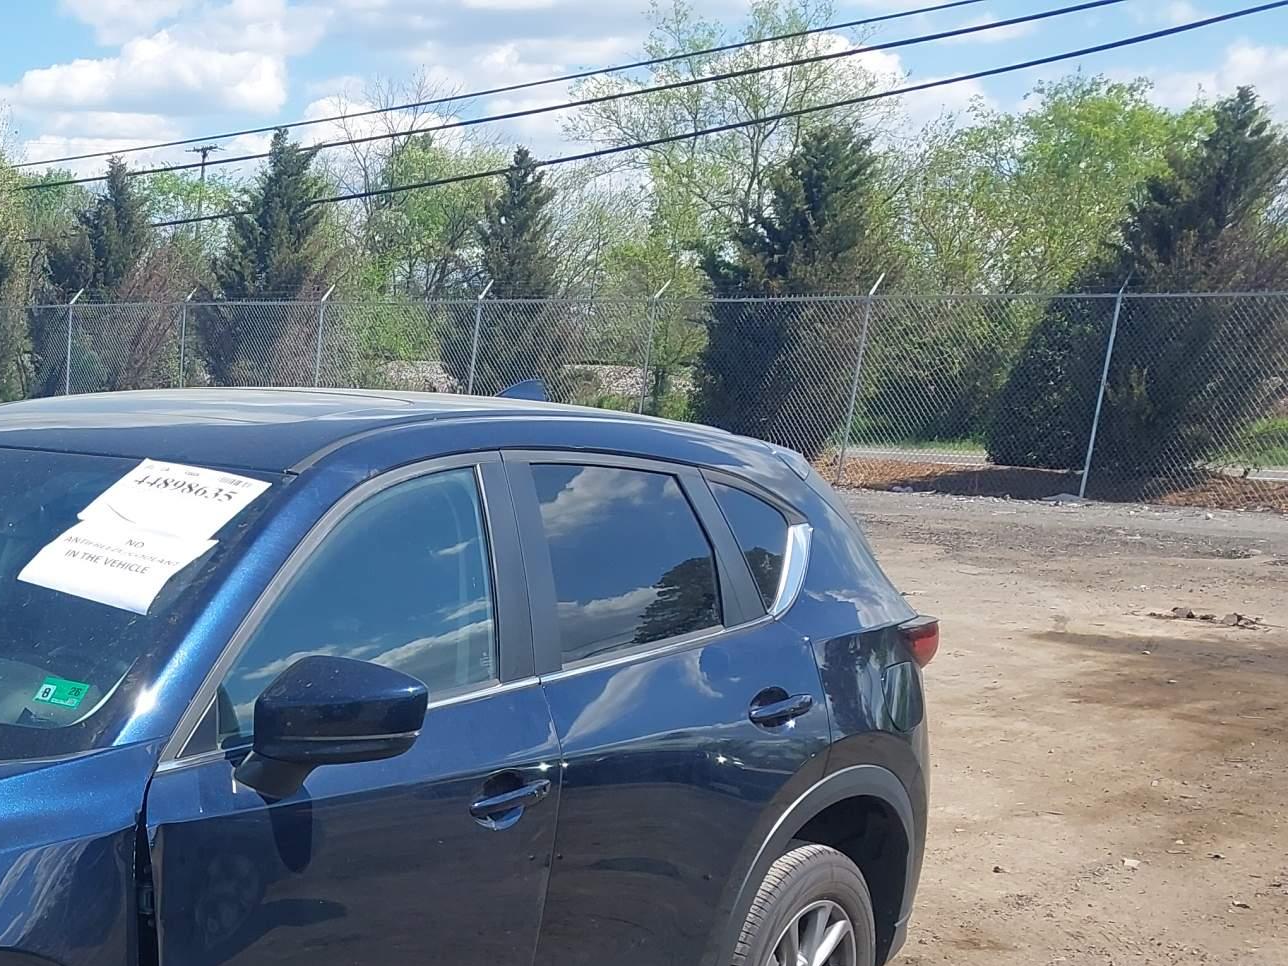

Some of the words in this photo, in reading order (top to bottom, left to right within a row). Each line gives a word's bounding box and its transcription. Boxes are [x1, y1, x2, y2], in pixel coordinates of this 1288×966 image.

[134, 474, 239, 502] 44898635
[126, 538, 145, 549] NO
[64, 549, 80, 559] IN
[80, 551, 103, 565] THE
[103, 557, 151, 575] VEHICLE
[42, 687, 52, 698] 8
